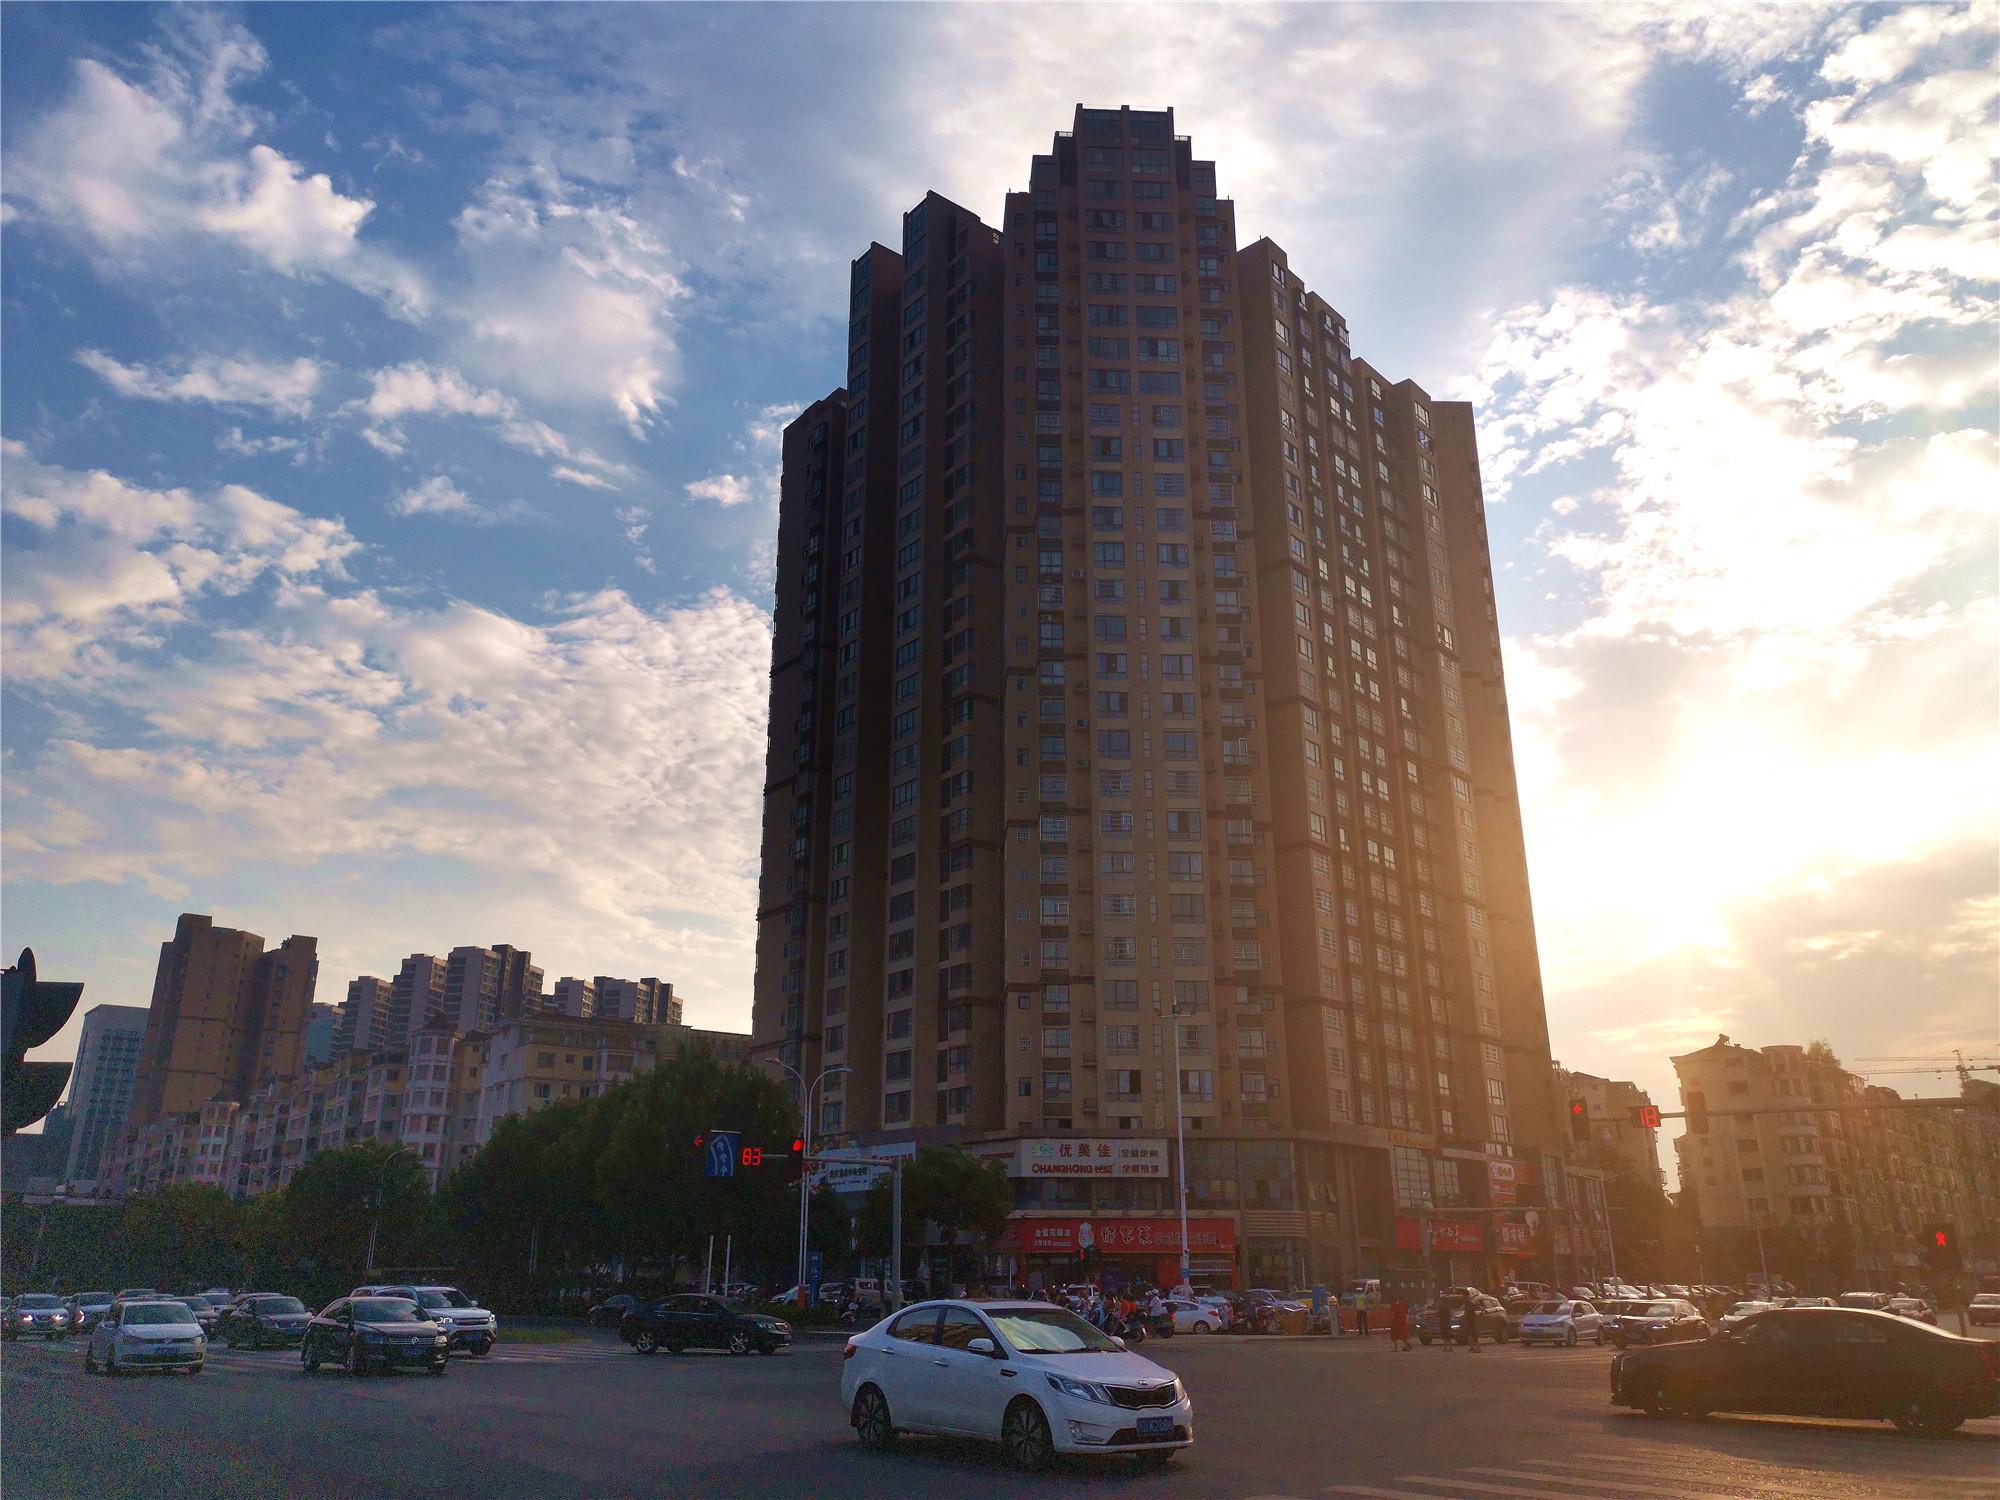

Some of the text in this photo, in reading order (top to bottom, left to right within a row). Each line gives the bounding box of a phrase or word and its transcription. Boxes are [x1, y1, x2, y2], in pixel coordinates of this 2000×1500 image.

[742, 1147, 761, 1166] 83
[1058, 1143, 1111, 1158] 优美佳
[1031, 1163, 1093, 1174] CHANGHONG
